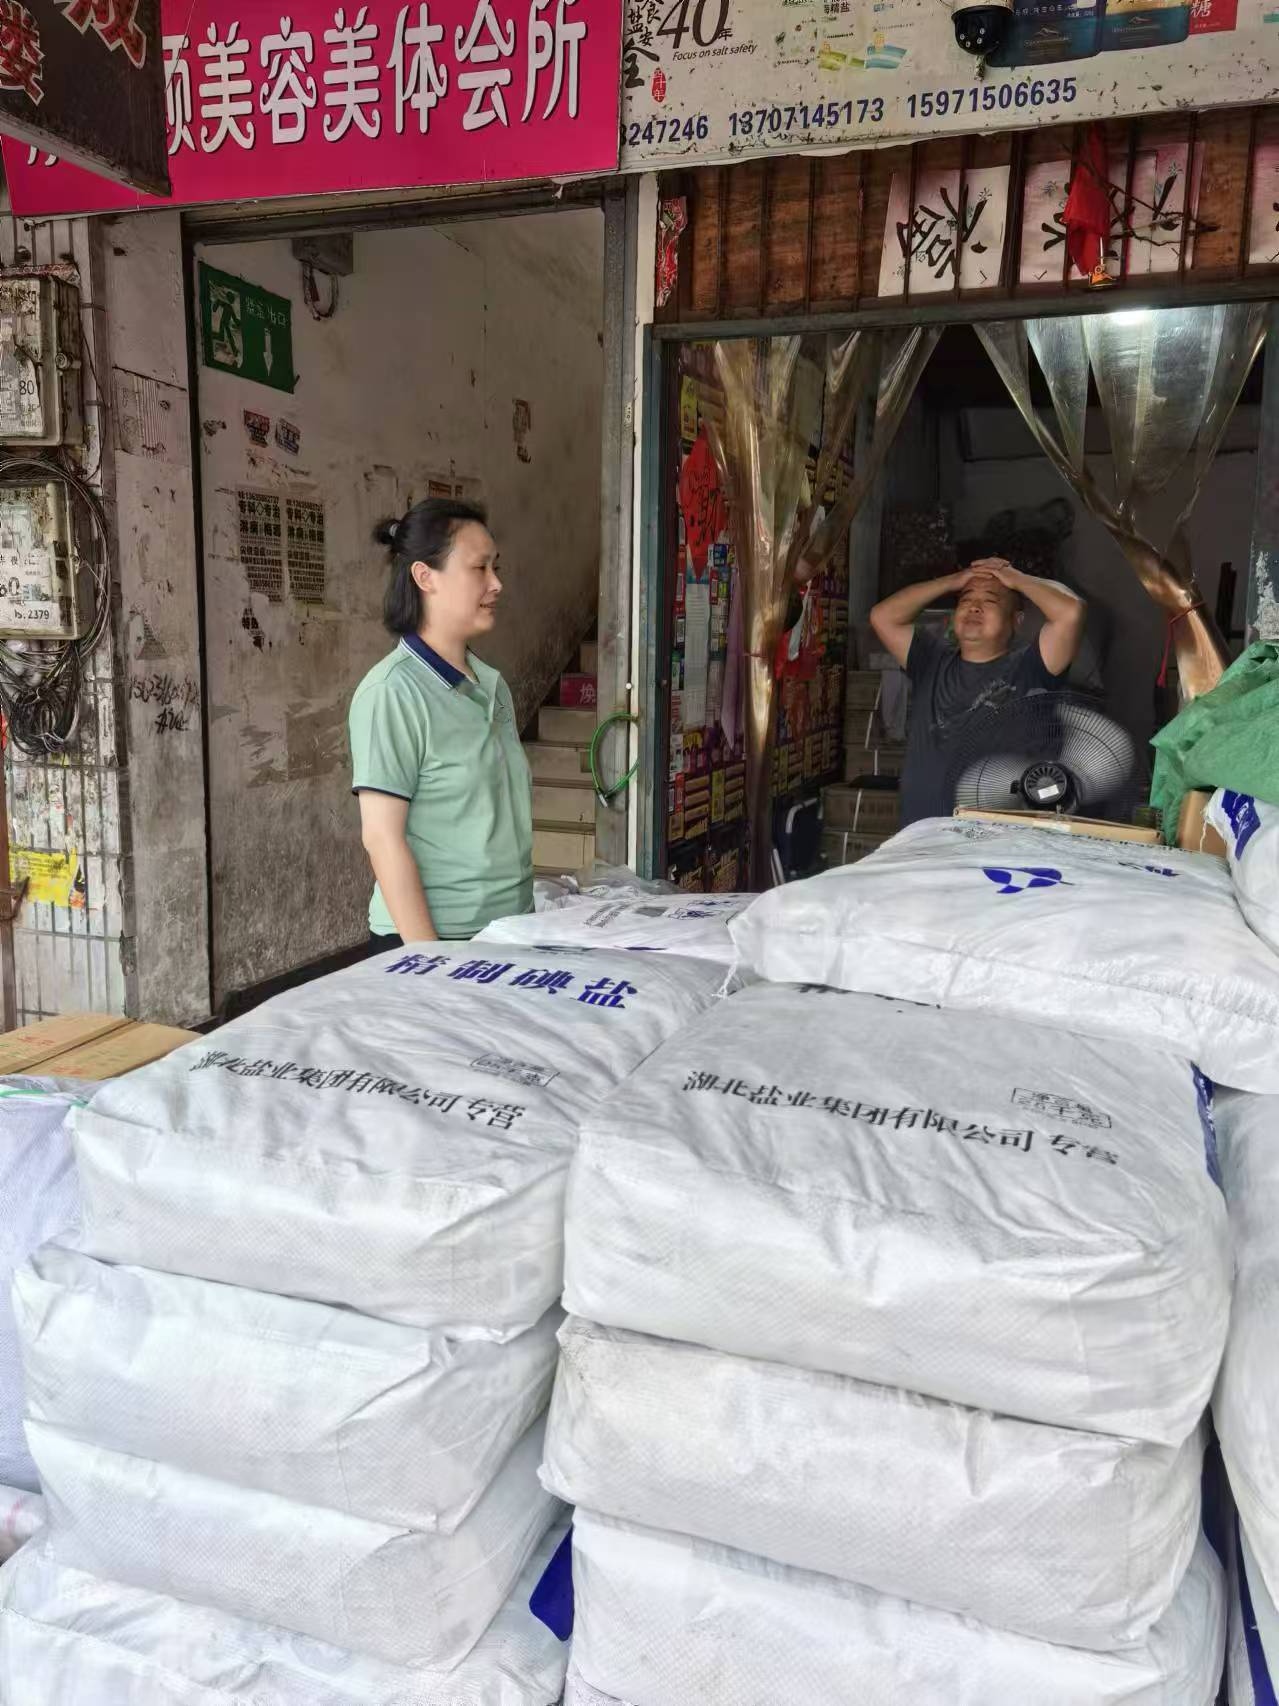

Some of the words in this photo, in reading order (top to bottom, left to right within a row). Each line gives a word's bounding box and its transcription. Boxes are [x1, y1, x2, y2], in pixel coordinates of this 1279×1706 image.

[672, 51, 698, 61] Focus
[699, 48, 710, 57] on
[712, 46, 728, 56] salt
[730, 43, 758, 55] safety
[729, 98, 884, 135] 13707145173
[907, 77, 1078, 118] 15971506635
[19, 380, 35, 395] 80
[385, 953, 638, 1009] 精制碘盐
